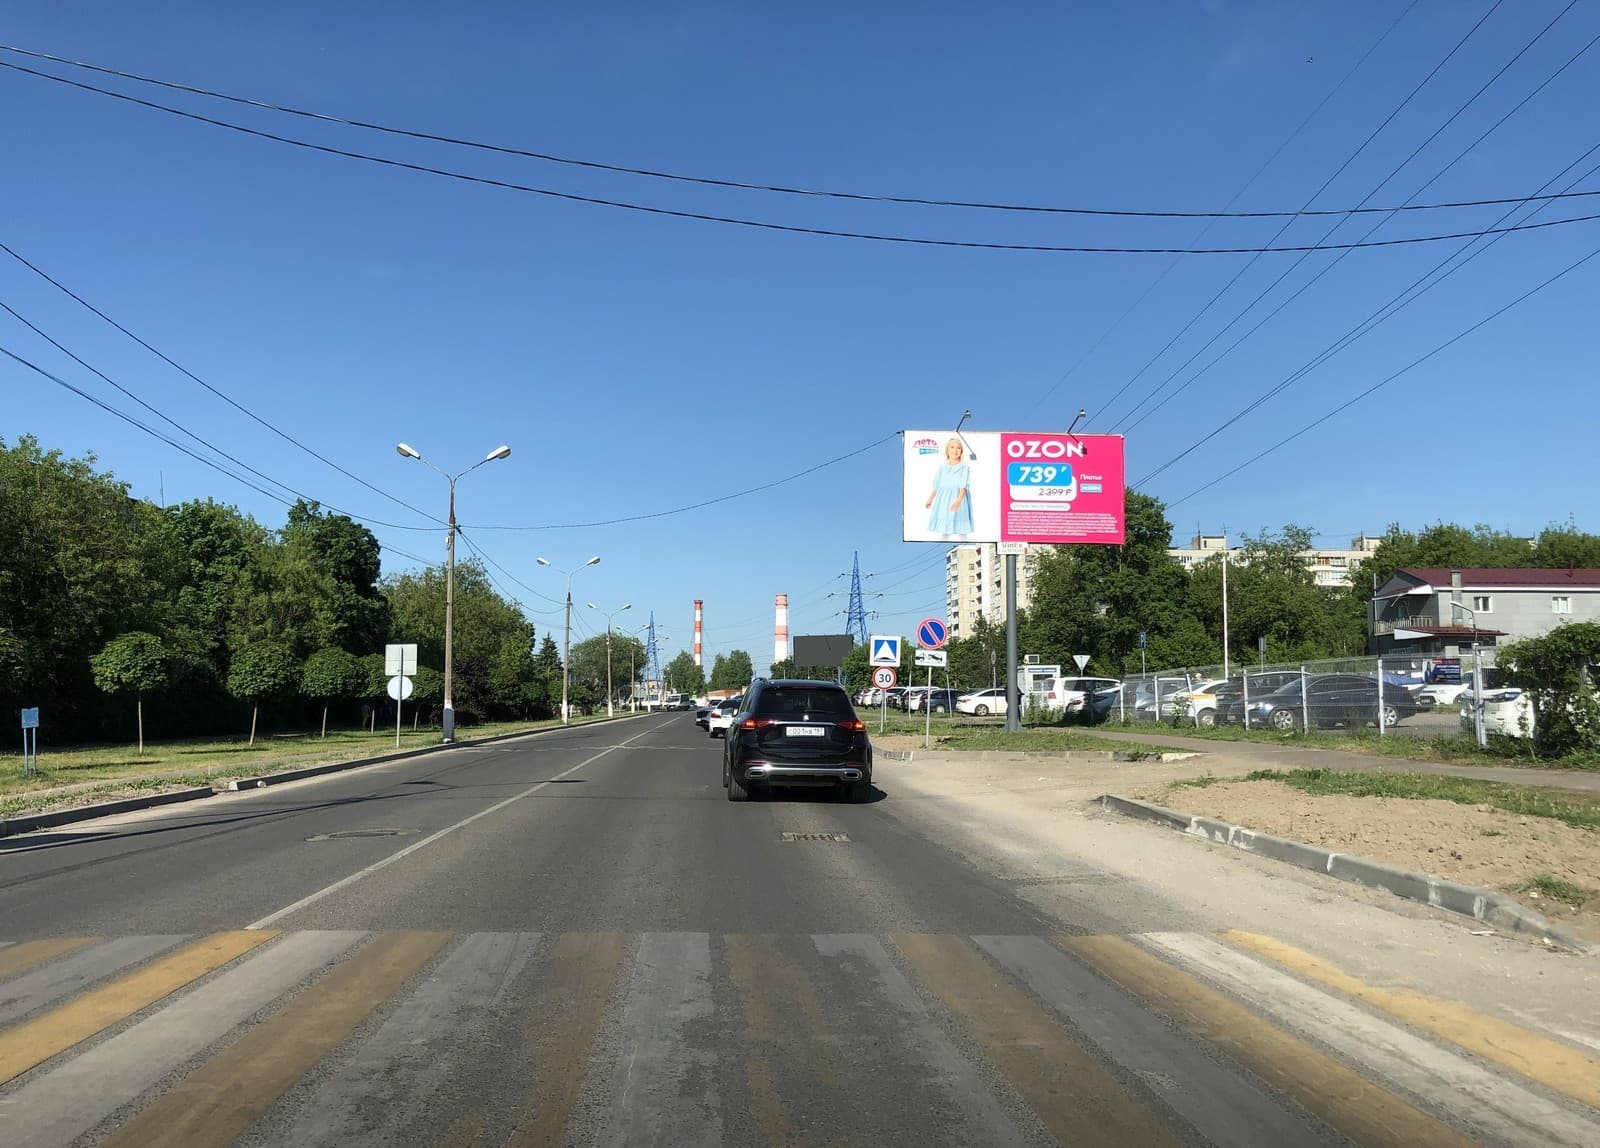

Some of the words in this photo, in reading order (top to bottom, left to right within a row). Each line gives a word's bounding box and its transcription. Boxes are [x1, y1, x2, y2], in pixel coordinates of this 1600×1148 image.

[1007, 440, 1083, 458] OZON
[1018, 466, 1057, 483] 739
[878, 673, 892, 683] 30
